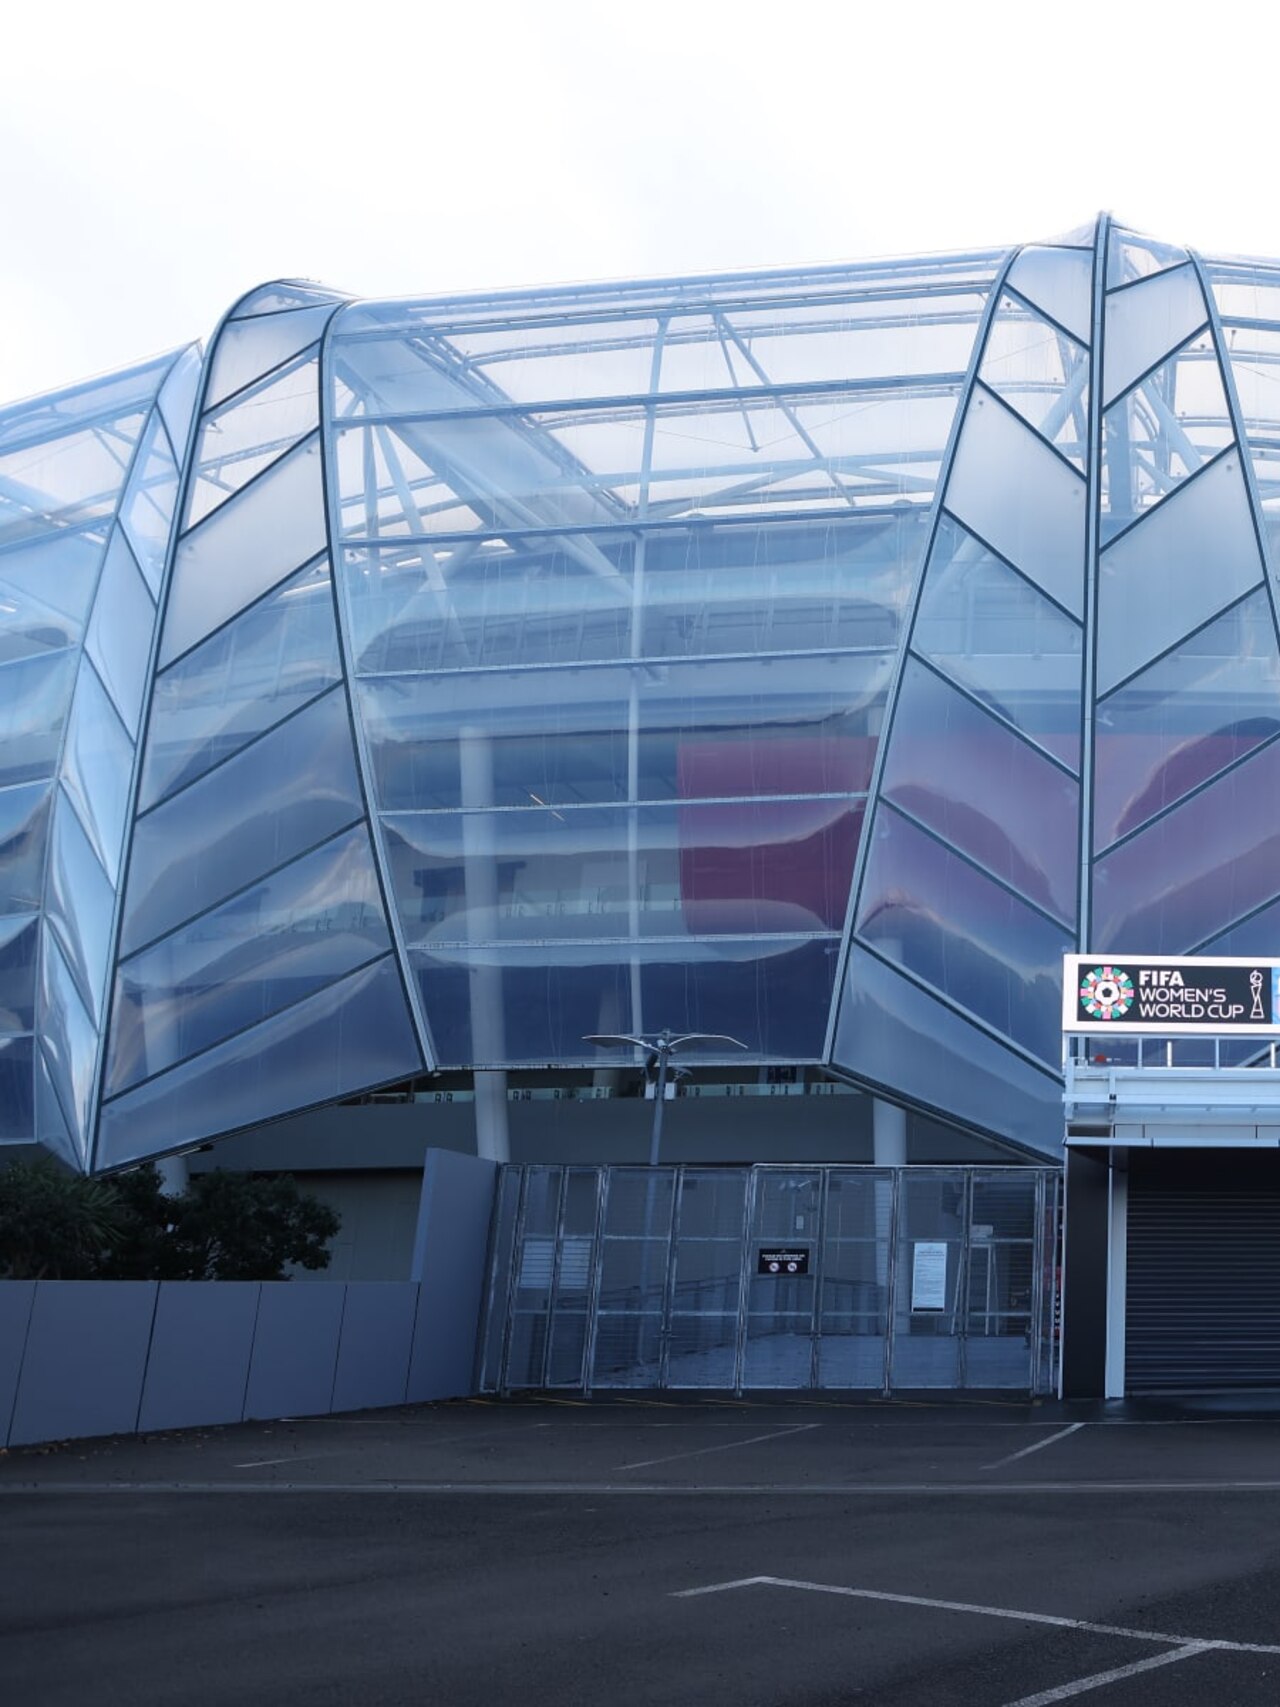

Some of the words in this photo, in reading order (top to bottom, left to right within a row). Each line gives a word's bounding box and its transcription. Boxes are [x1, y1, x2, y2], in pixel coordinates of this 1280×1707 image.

[1139, 970, 1185, 987] FIFA
[1139, 987, 1227, 1003] WOMEN'S
[1139, 1003, 1205, 1018] WORLD
[1207, 1004, 1245, 1019] CUP
